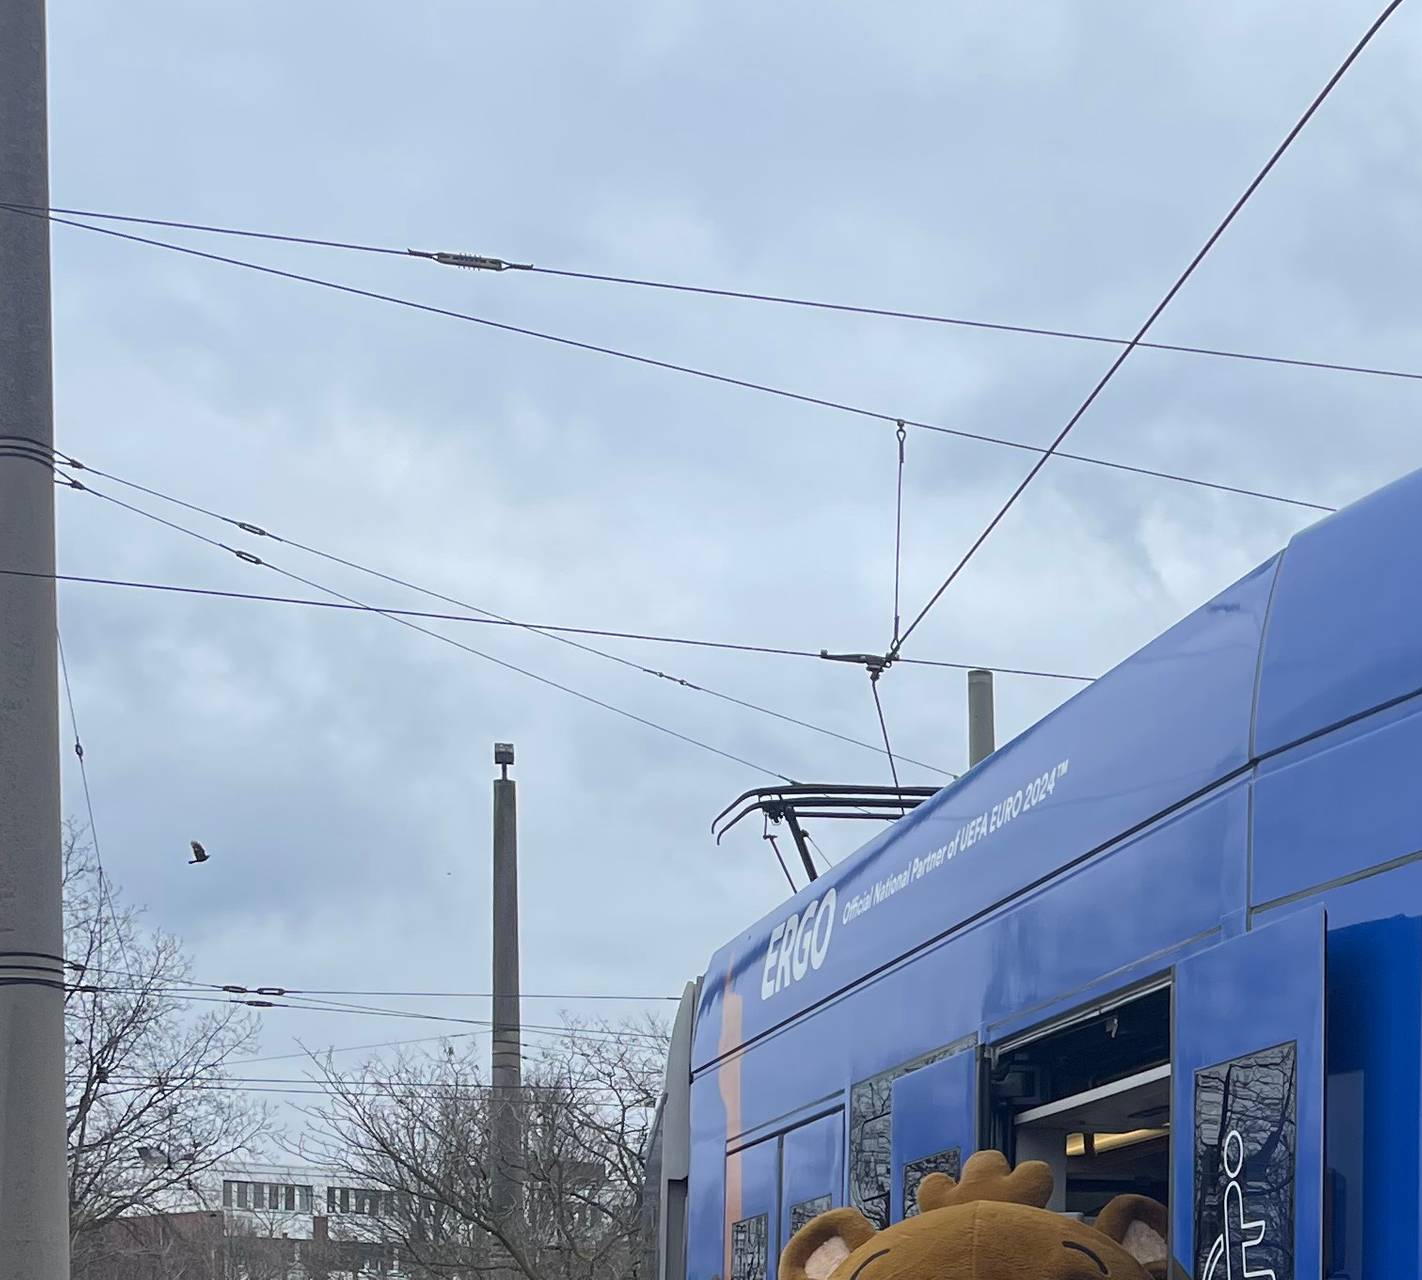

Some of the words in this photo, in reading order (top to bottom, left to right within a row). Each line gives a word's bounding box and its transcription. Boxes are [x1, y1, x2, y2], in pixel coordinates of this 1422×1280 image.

[842, 886, 874, 925] Official
[873, 861, 912, 905] National
[911, 846, 947, 883] Partner
[947, 829, 961, 859] of
[960, 812, 988, 852] UEFA
[989, 790, 1022, 833] EURO
[761, 887, 837, 1000] ERGO
